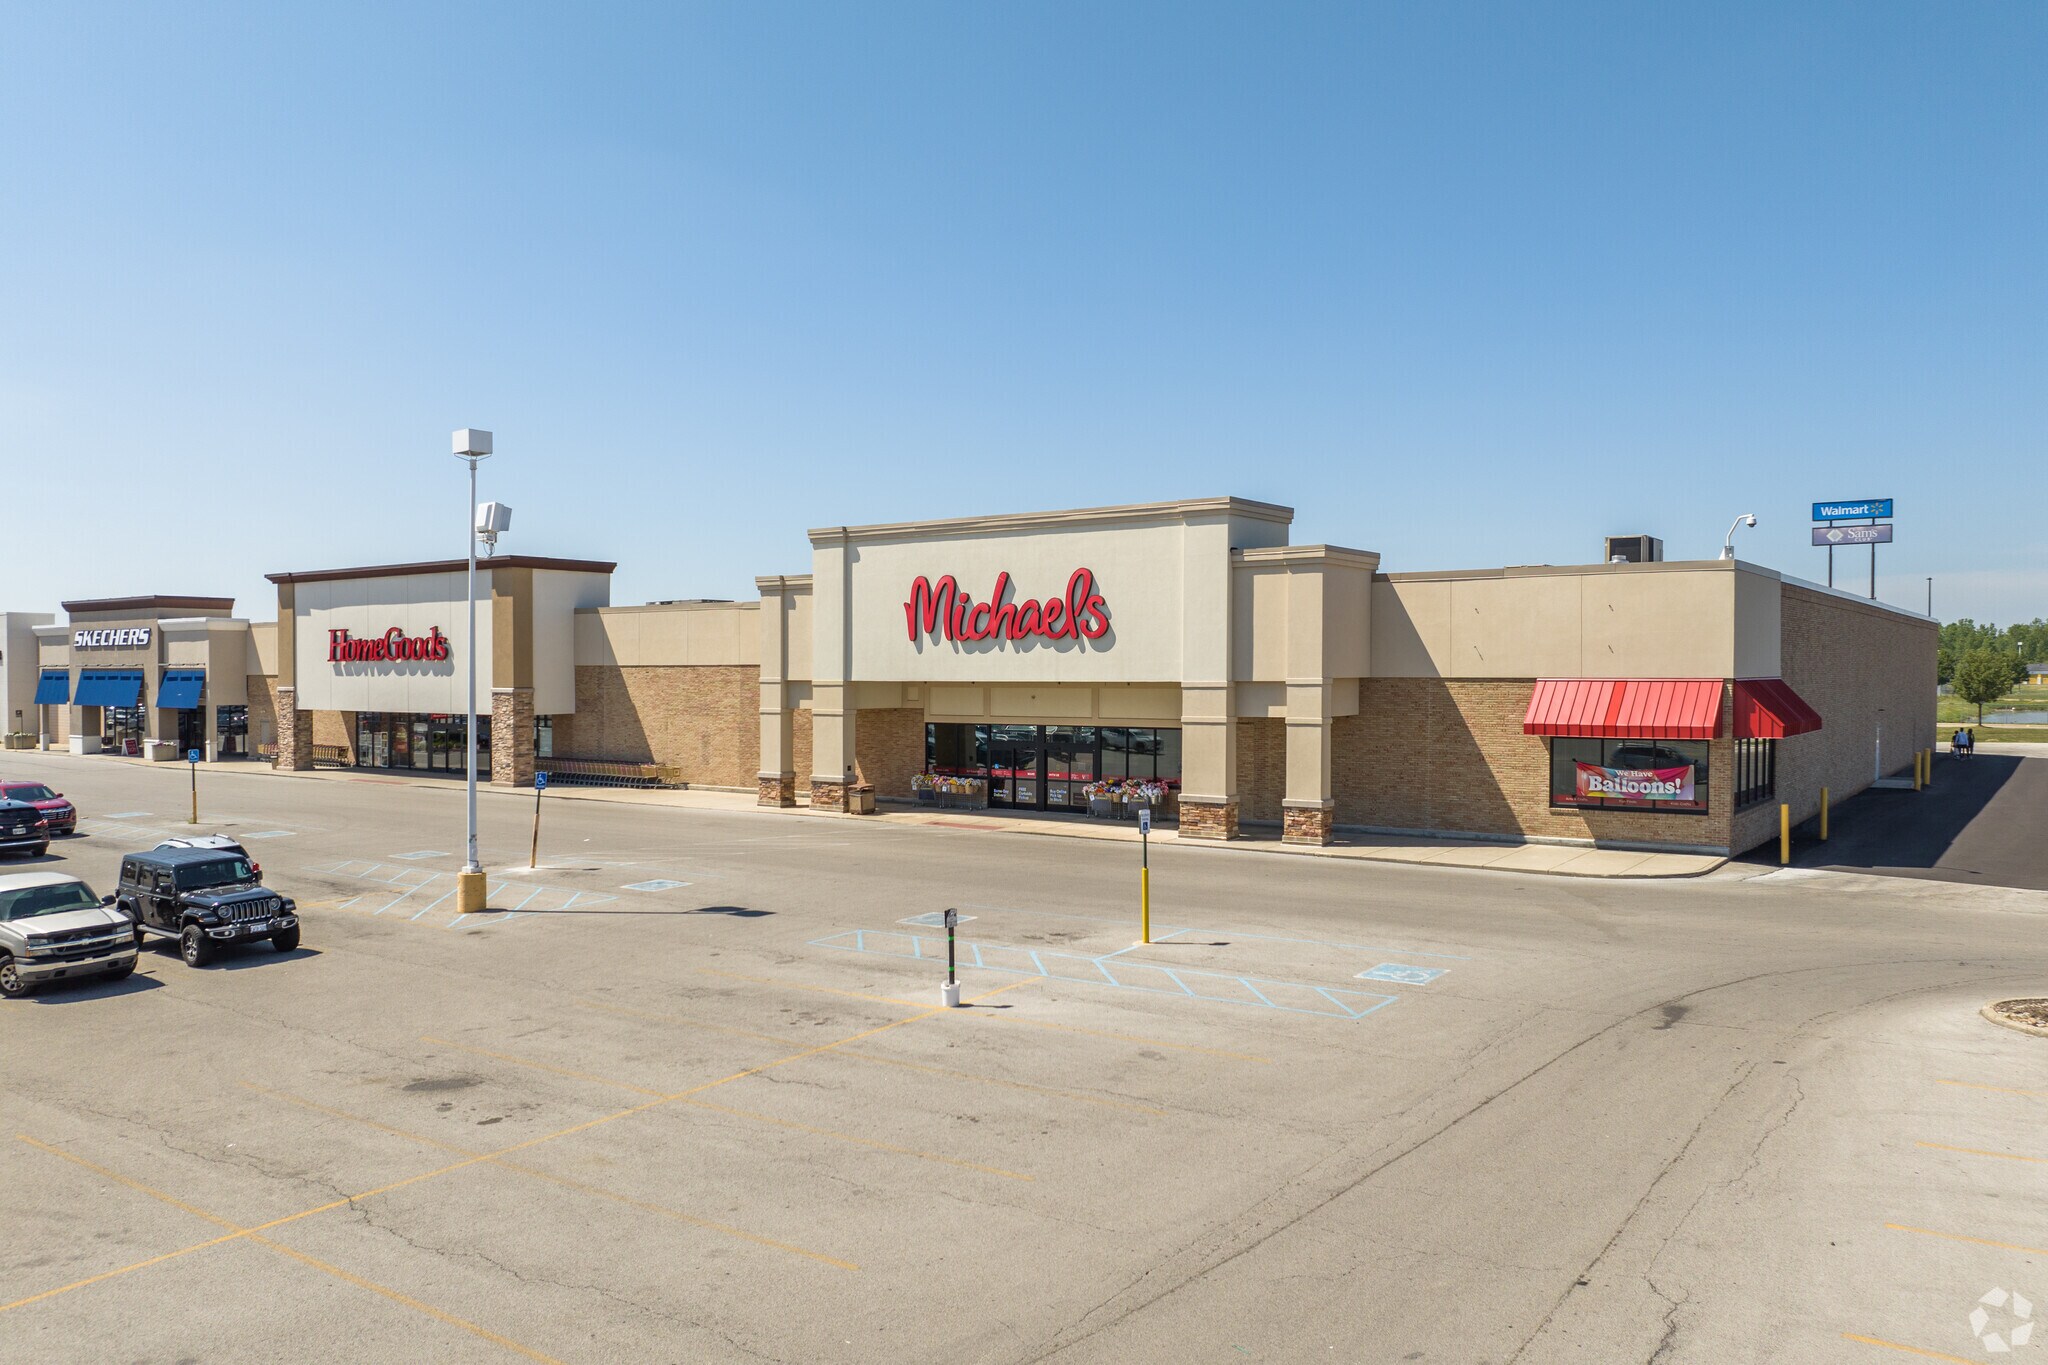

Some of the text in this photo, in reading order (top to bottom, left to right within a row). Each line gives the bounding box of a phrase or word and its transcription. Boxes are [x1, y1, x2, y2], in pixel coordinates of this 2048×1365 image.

[1820, 504, 1869, 516] Walmart
[1847, 527, 1878, 539] Sam's
[904, 567, 1109, 641] Michaels
[73, 628, 151, 647] SKECHERS
[327, 625, 448, 662] HomeGoods
[1615, 769, 1653, 778] We Have
[1588, 775, 1682, 795] Balloons!
